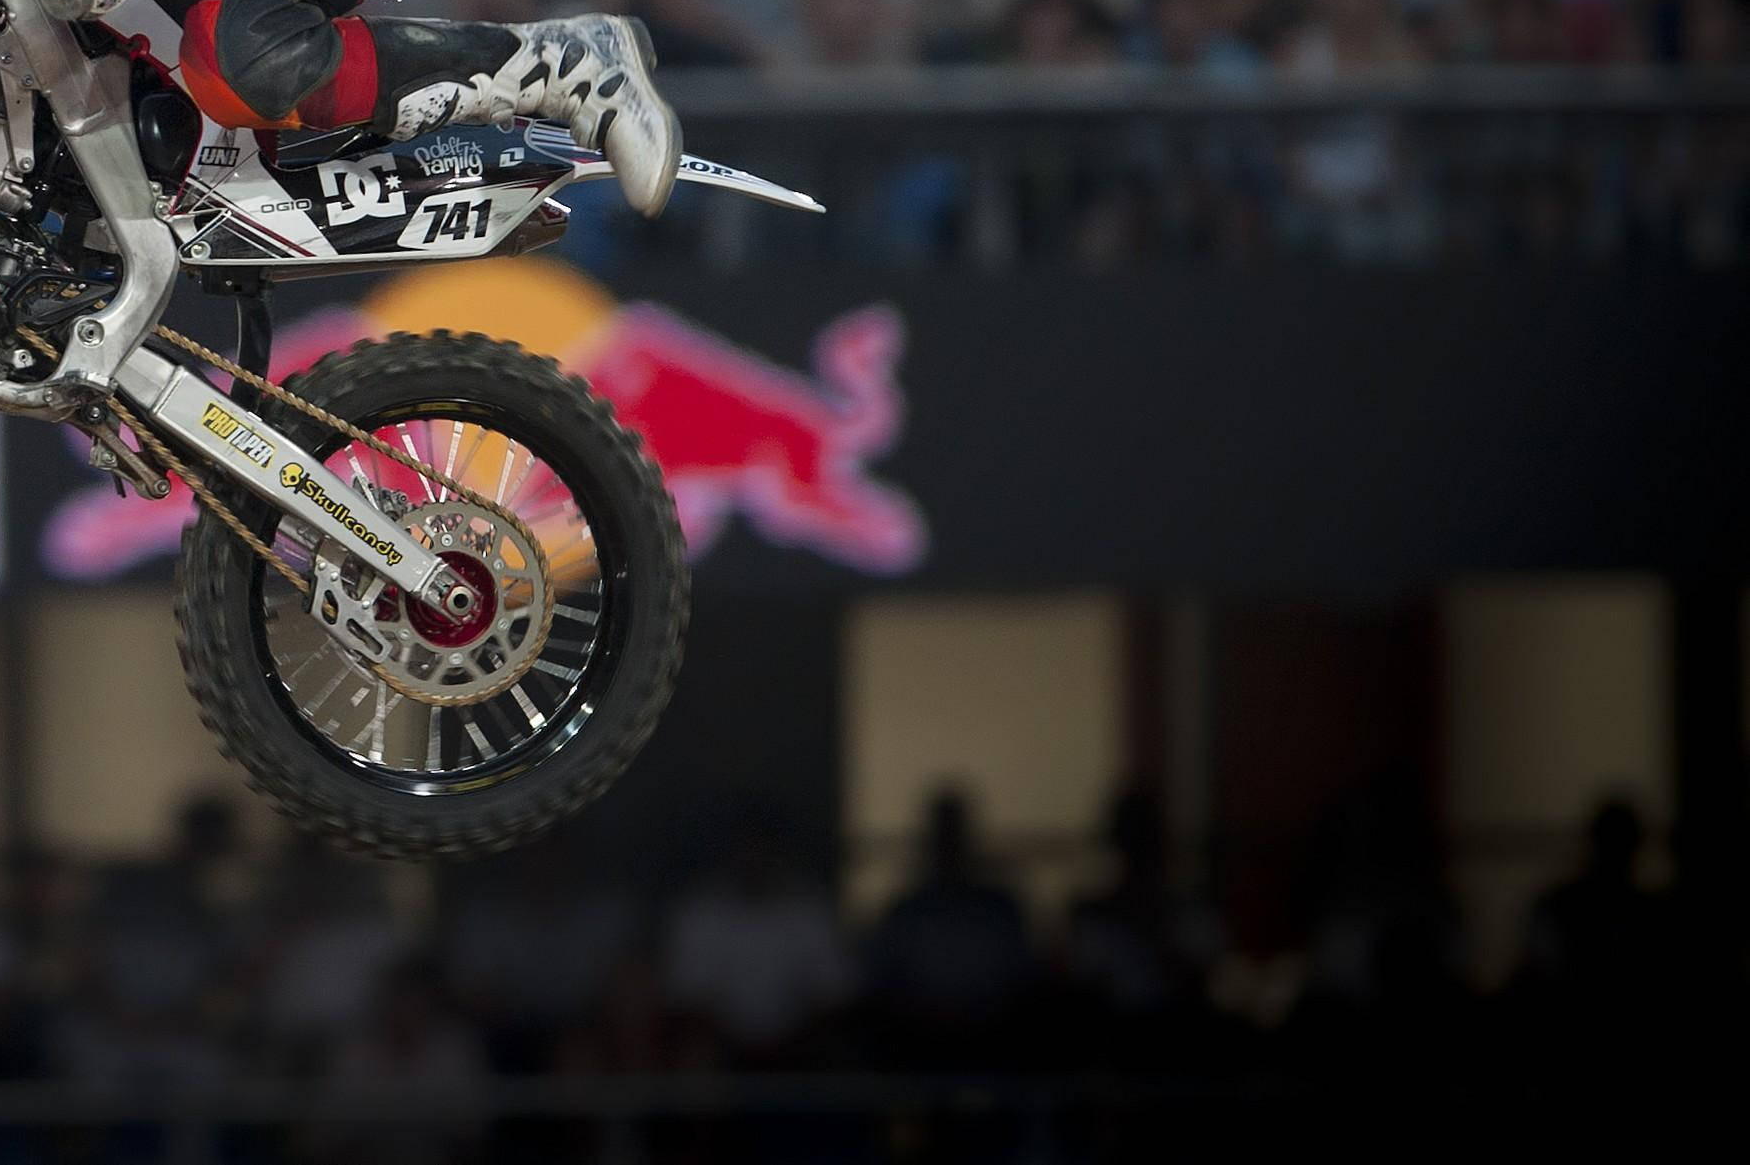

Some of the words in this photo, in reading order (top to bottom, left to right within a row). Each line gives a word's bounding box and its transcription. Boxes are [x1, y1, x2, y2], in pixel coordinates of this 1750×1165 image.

[202, 147, 237, 166] UNI
[261, 199, 312, 214] OGIO
[318, 153, 407, 226] DC
[423, 199, 492, 244] 741
[302, 478, 403, 566] Skullcandy
